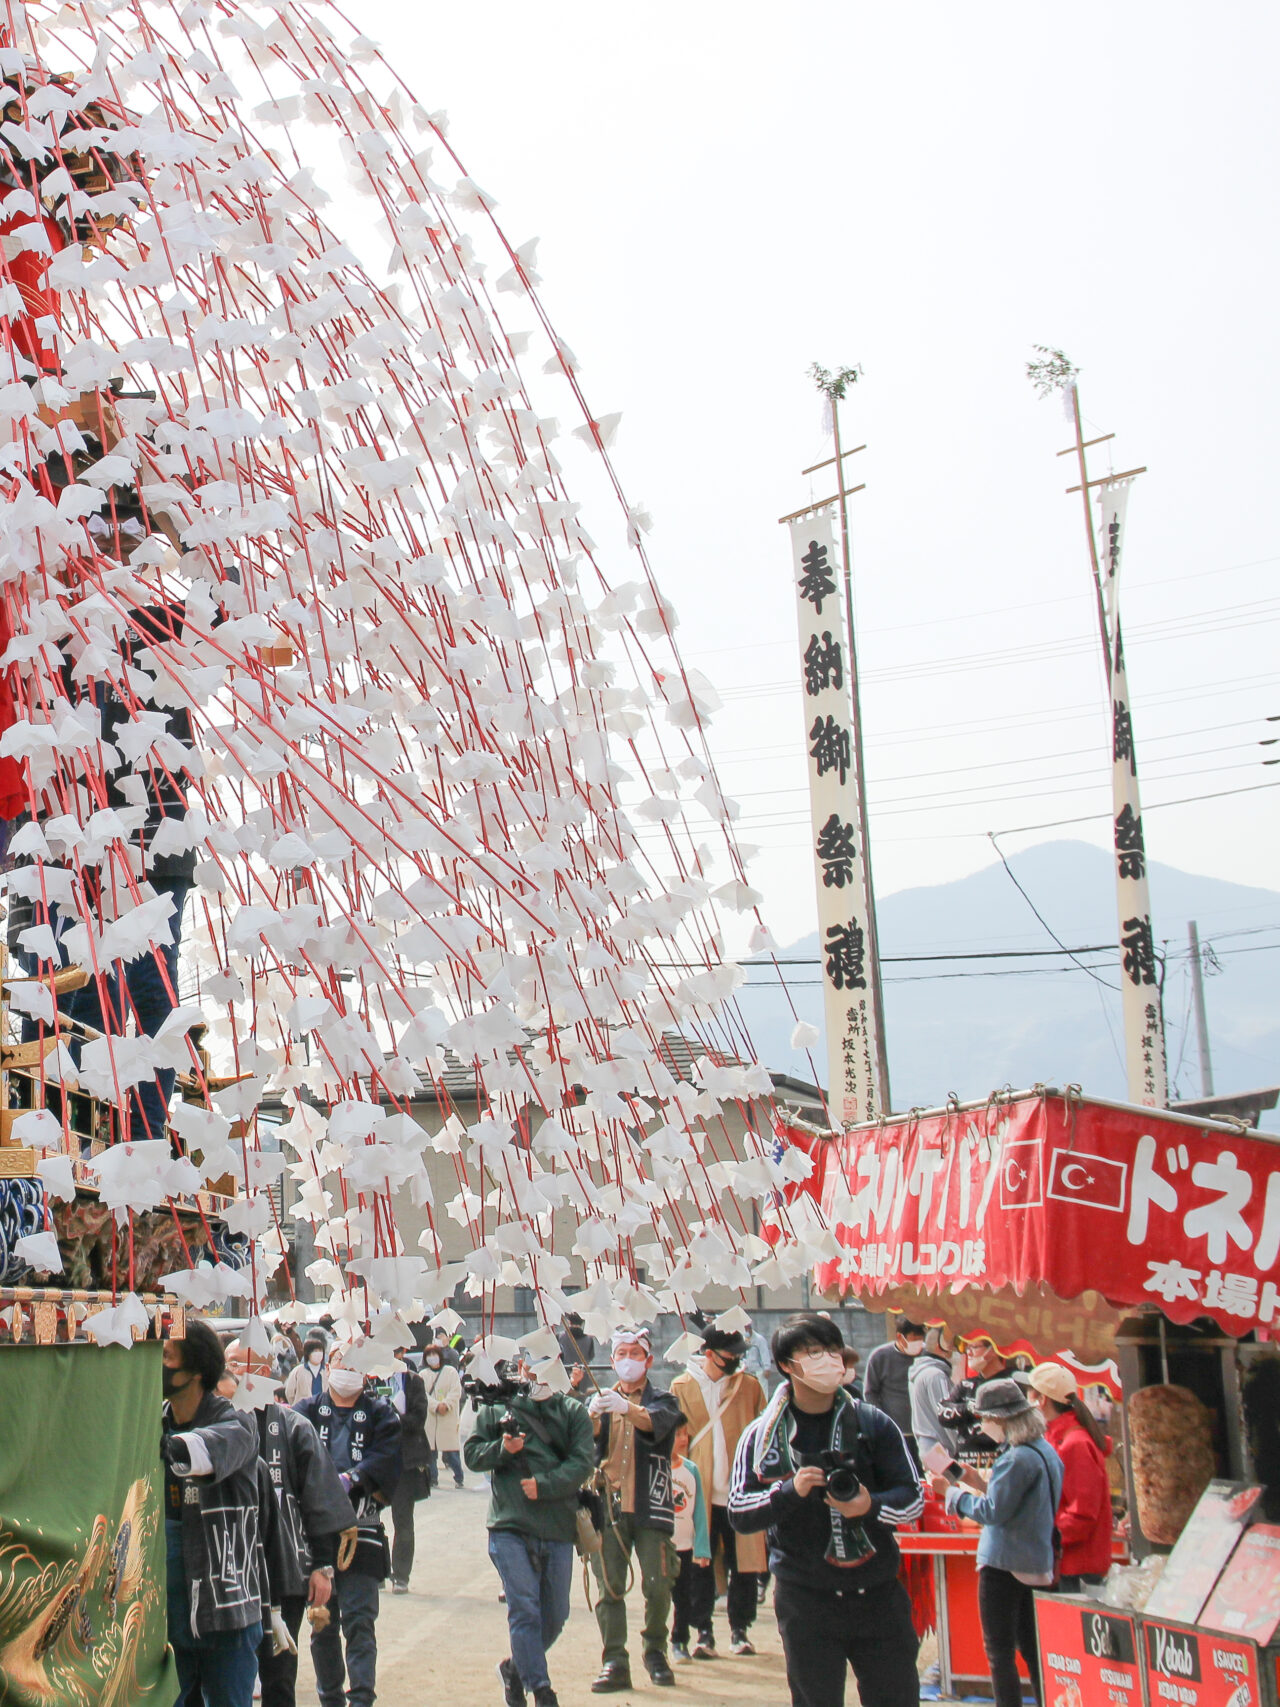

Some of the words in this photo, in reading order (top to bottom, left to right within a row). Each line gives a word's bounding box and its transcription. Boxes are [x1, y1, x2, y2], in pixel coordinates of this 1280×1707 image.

[798, 541, 867, 990] 奉納御祭禮
[836, 1238, 987, 1278] 本場トルコの味
[1155, 1627, 1193, 1679] Kebab
